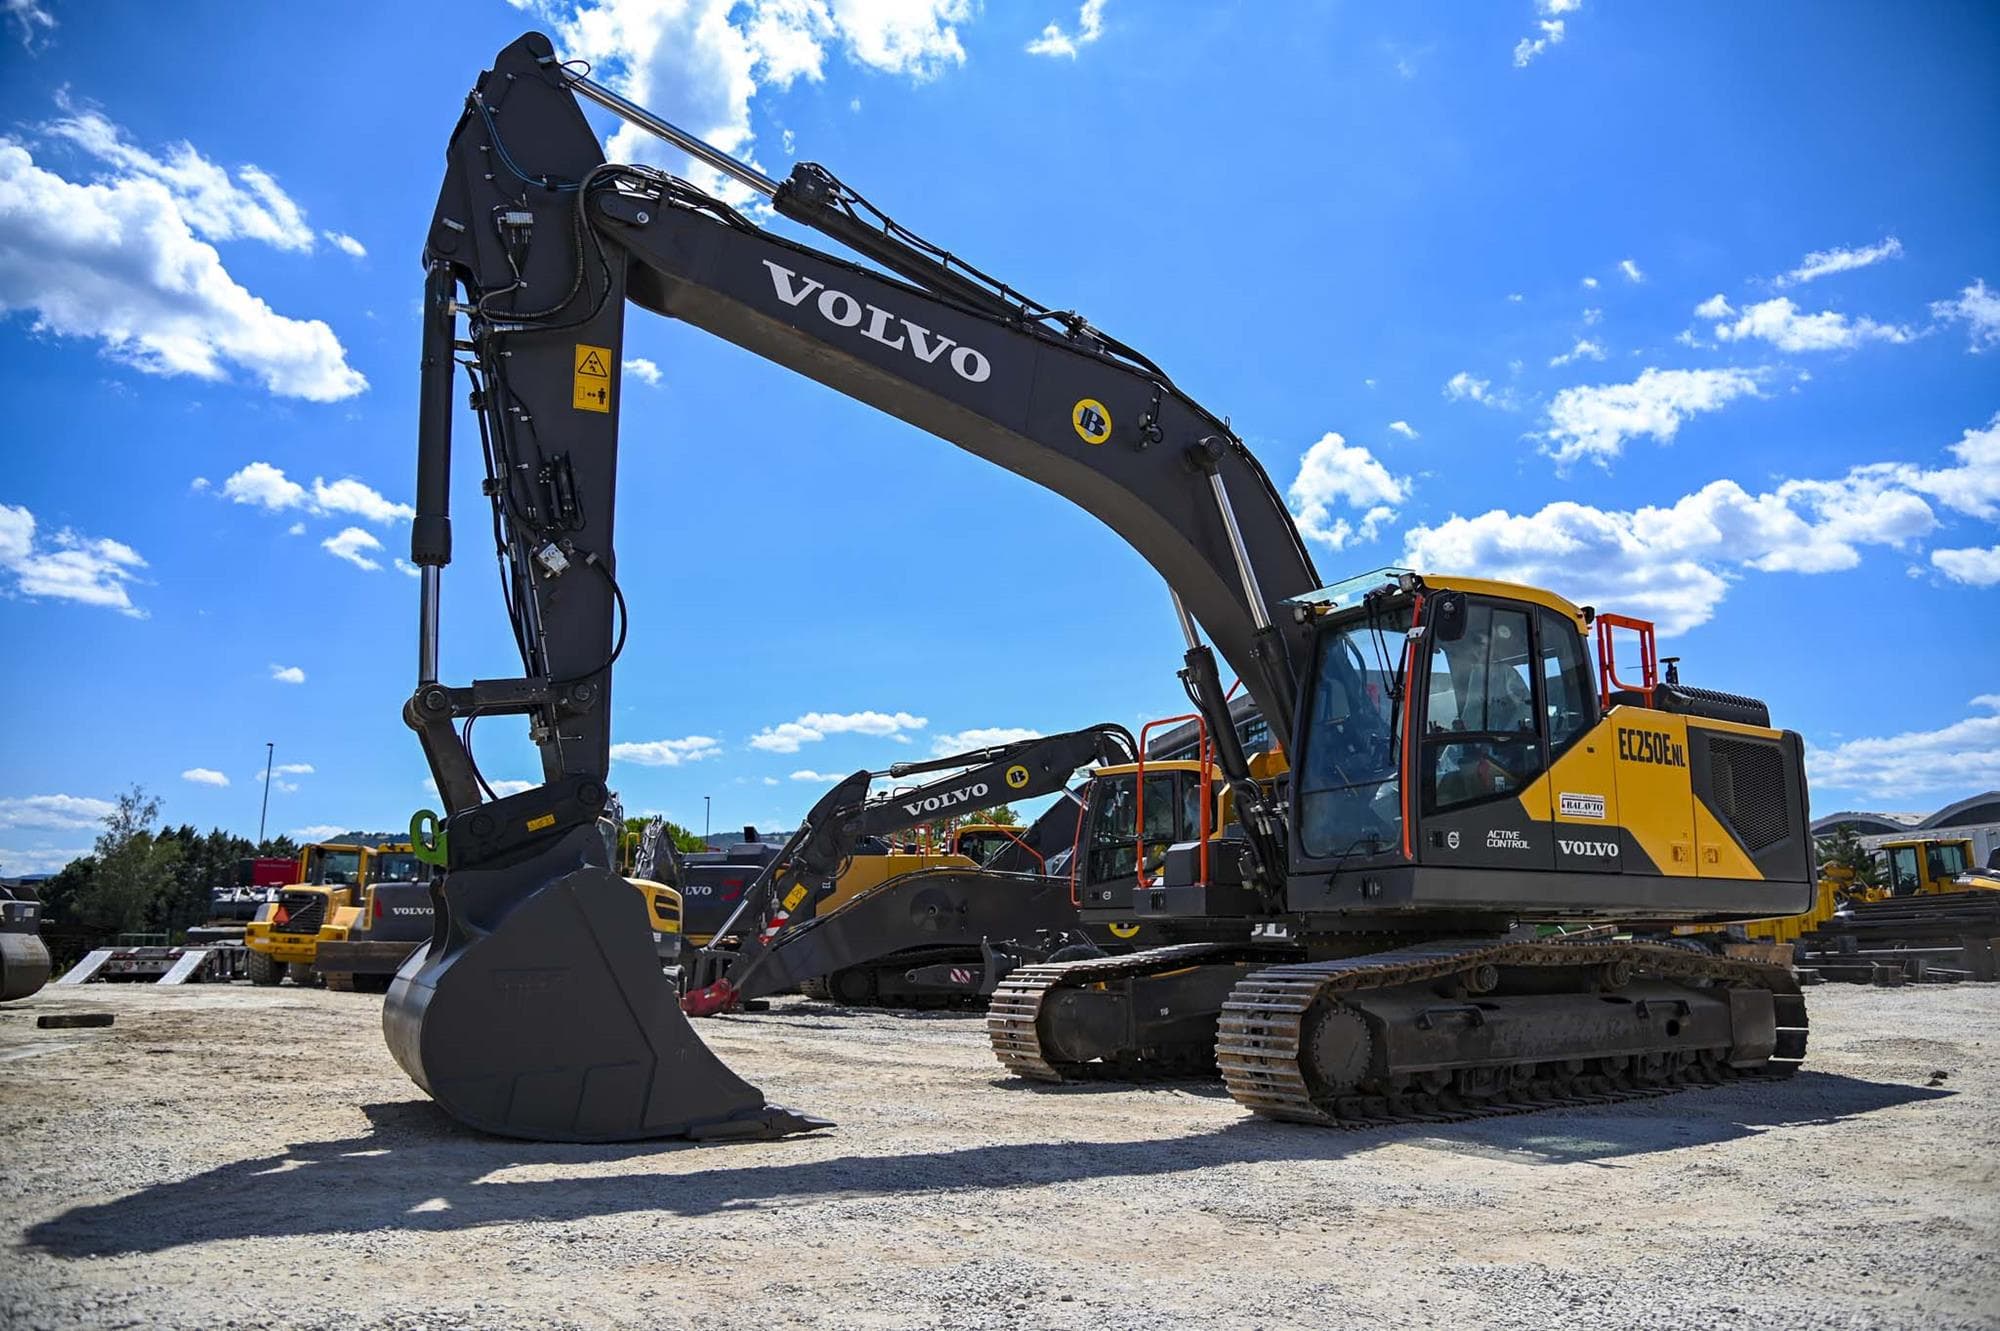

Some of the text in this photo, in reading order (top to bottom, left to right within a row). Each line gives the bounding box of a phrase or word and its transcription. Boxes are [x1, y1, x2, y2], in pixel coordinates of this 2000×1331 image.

[762, 259, 992, 383] VOLVO
[1080, 406, 1106, 437] B
[902, 783, 989, 816] VOLVO
[1487, 830, 1520, 840] ACTIVE
[1486, 839, 1531, 849] CONTROL
[1557, 840, 1619, 857] VOLVO
[681, 886, 713, 896] LVO
[391, 907, 434, 915] VOLVO
